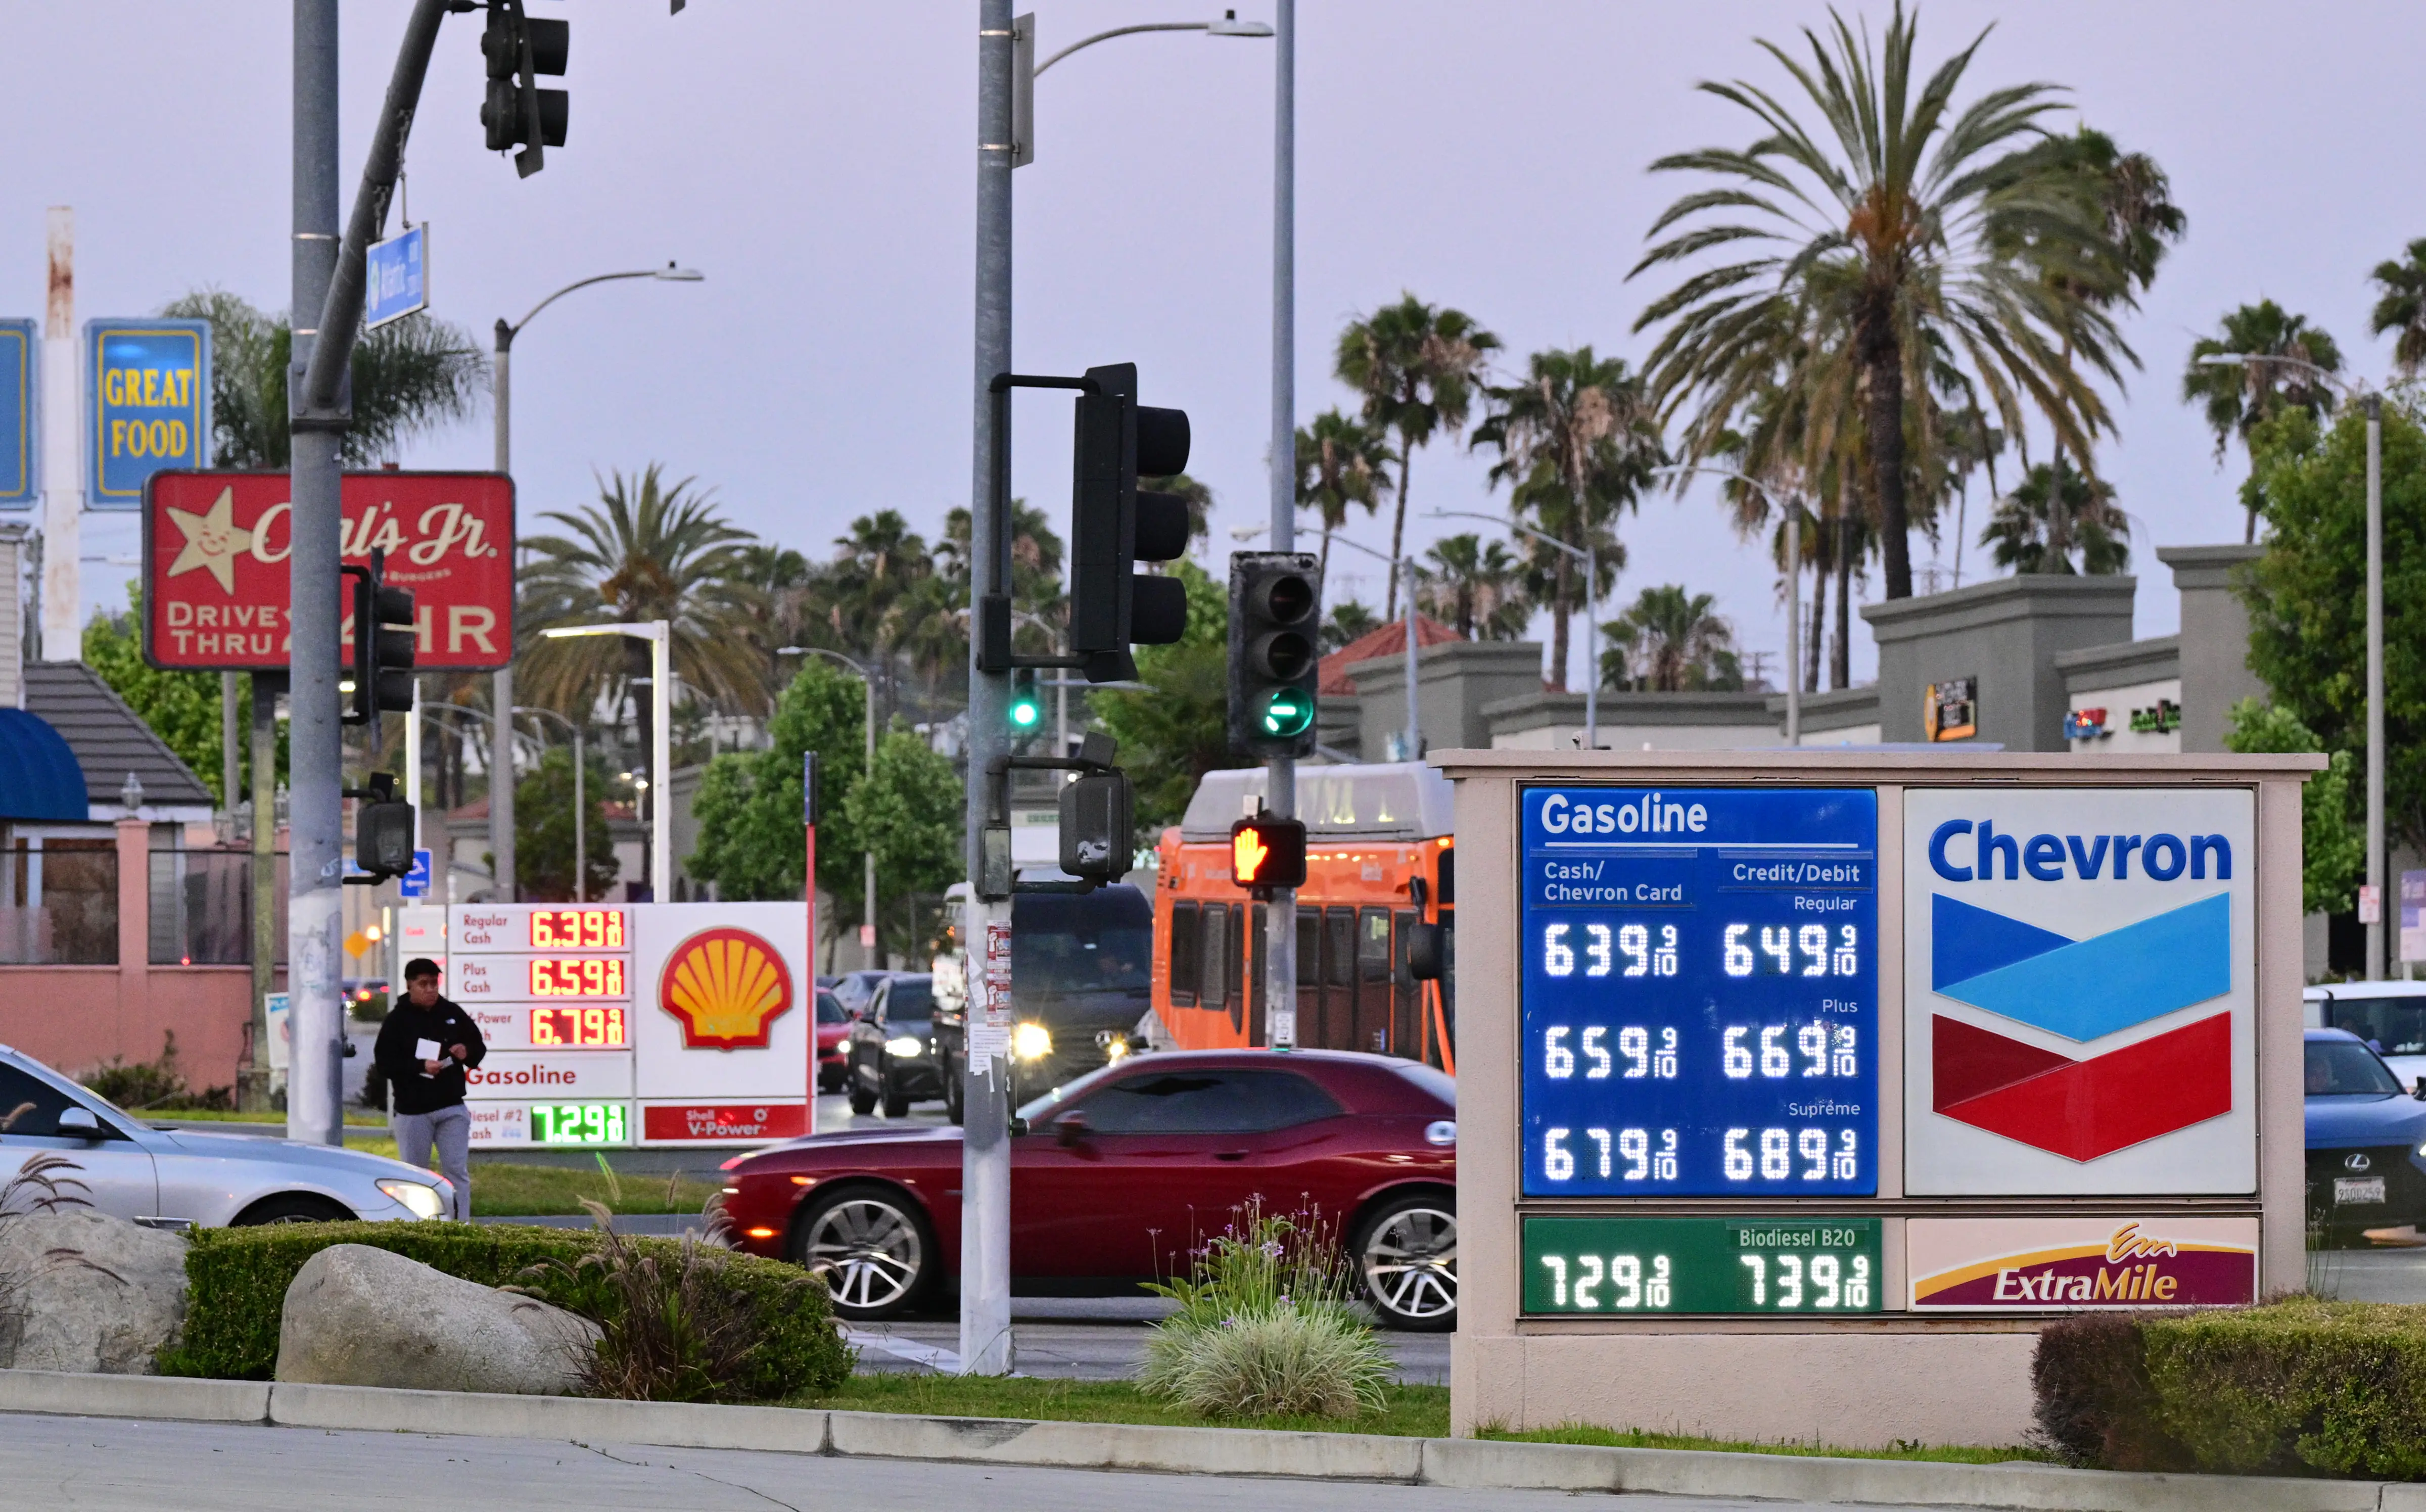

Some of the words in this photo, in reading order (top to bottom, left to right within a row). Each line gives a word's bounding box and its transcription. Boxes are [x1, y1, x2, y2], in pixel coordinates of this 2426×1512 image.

[105, 368, 192, 406] GREAT
[111, 419, 188, 457] FOOD
[409, 503, 498, 565] Jr.
[167, 601, 278, 627] DRIVE
[171, 630, 272, 655] THRU
[1542, 792, 1707, 833] Gasoline
[1928, 819, 2232, 882] Chevron
[1545, 861, 1605, 880] Cash/
[1733, 863, 1859, 883] Credit/Debit
[1544, 883, 1628, 901] Chevron
[1635, 883, 1682, 901] Card
[1795, 896, 1857, 913] Regular
[463, 914, 507, 930] Regular
[464, 931, 491, 944] Cash
[463, 962, 486, 975] Plus
[463, 981, 490, 993] Cash
[1822, 999, 1857, 1013] Plus
[465, 1064, 577, 1085] Gasoline
[504, 1109, 523, 1121] #2
[686, 1108, 715, 1120] Shell
[1789, 1102, 1860, 1118] Supreme
[687, 1121, 761, 1136] V-Power
[1740, 1228, 1815, 1247] Biodiesel
[1822, 1229, 1855, 1247] B20
[1992, 1264, 2177, 1300] ExtraMile
